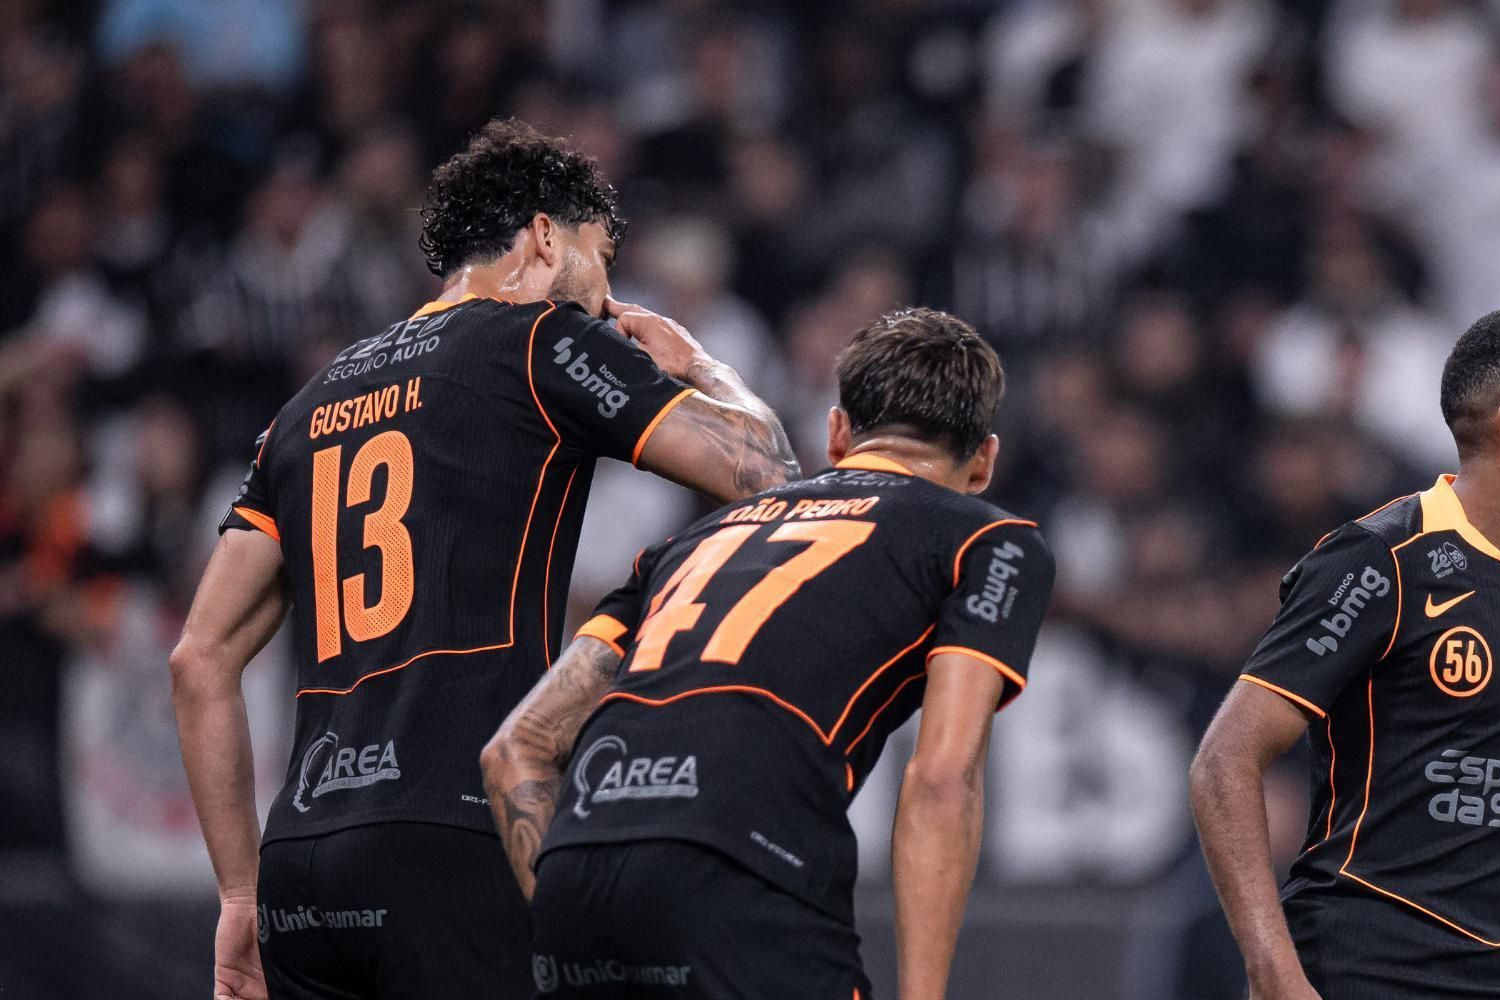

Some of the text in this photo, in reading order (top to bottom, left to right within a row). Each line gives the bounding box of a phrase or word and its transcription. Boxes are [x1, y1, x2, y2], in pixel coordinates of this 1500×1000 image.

[323, 335, 440, 384] SEGURO AUTO
[599, 364, 627, 388] banco
[309, 376, 424, 440] GUSTAVO H.
[565, 351, 630, 419] bmg
[784, 496, 880, 521] PEDRO
[311, 430, 414, 663] 13
[629, 519, 877, 672] 47
[966, 557, 1019, 623] bmg
[1320, 566, 1390, 638] bmg
[1328, 573, 1354, 606] banco
[1443, 640, 1482, 684] 56
[319, 740, 399, 788] AREA
[599, 755, 697, 790] AREA
